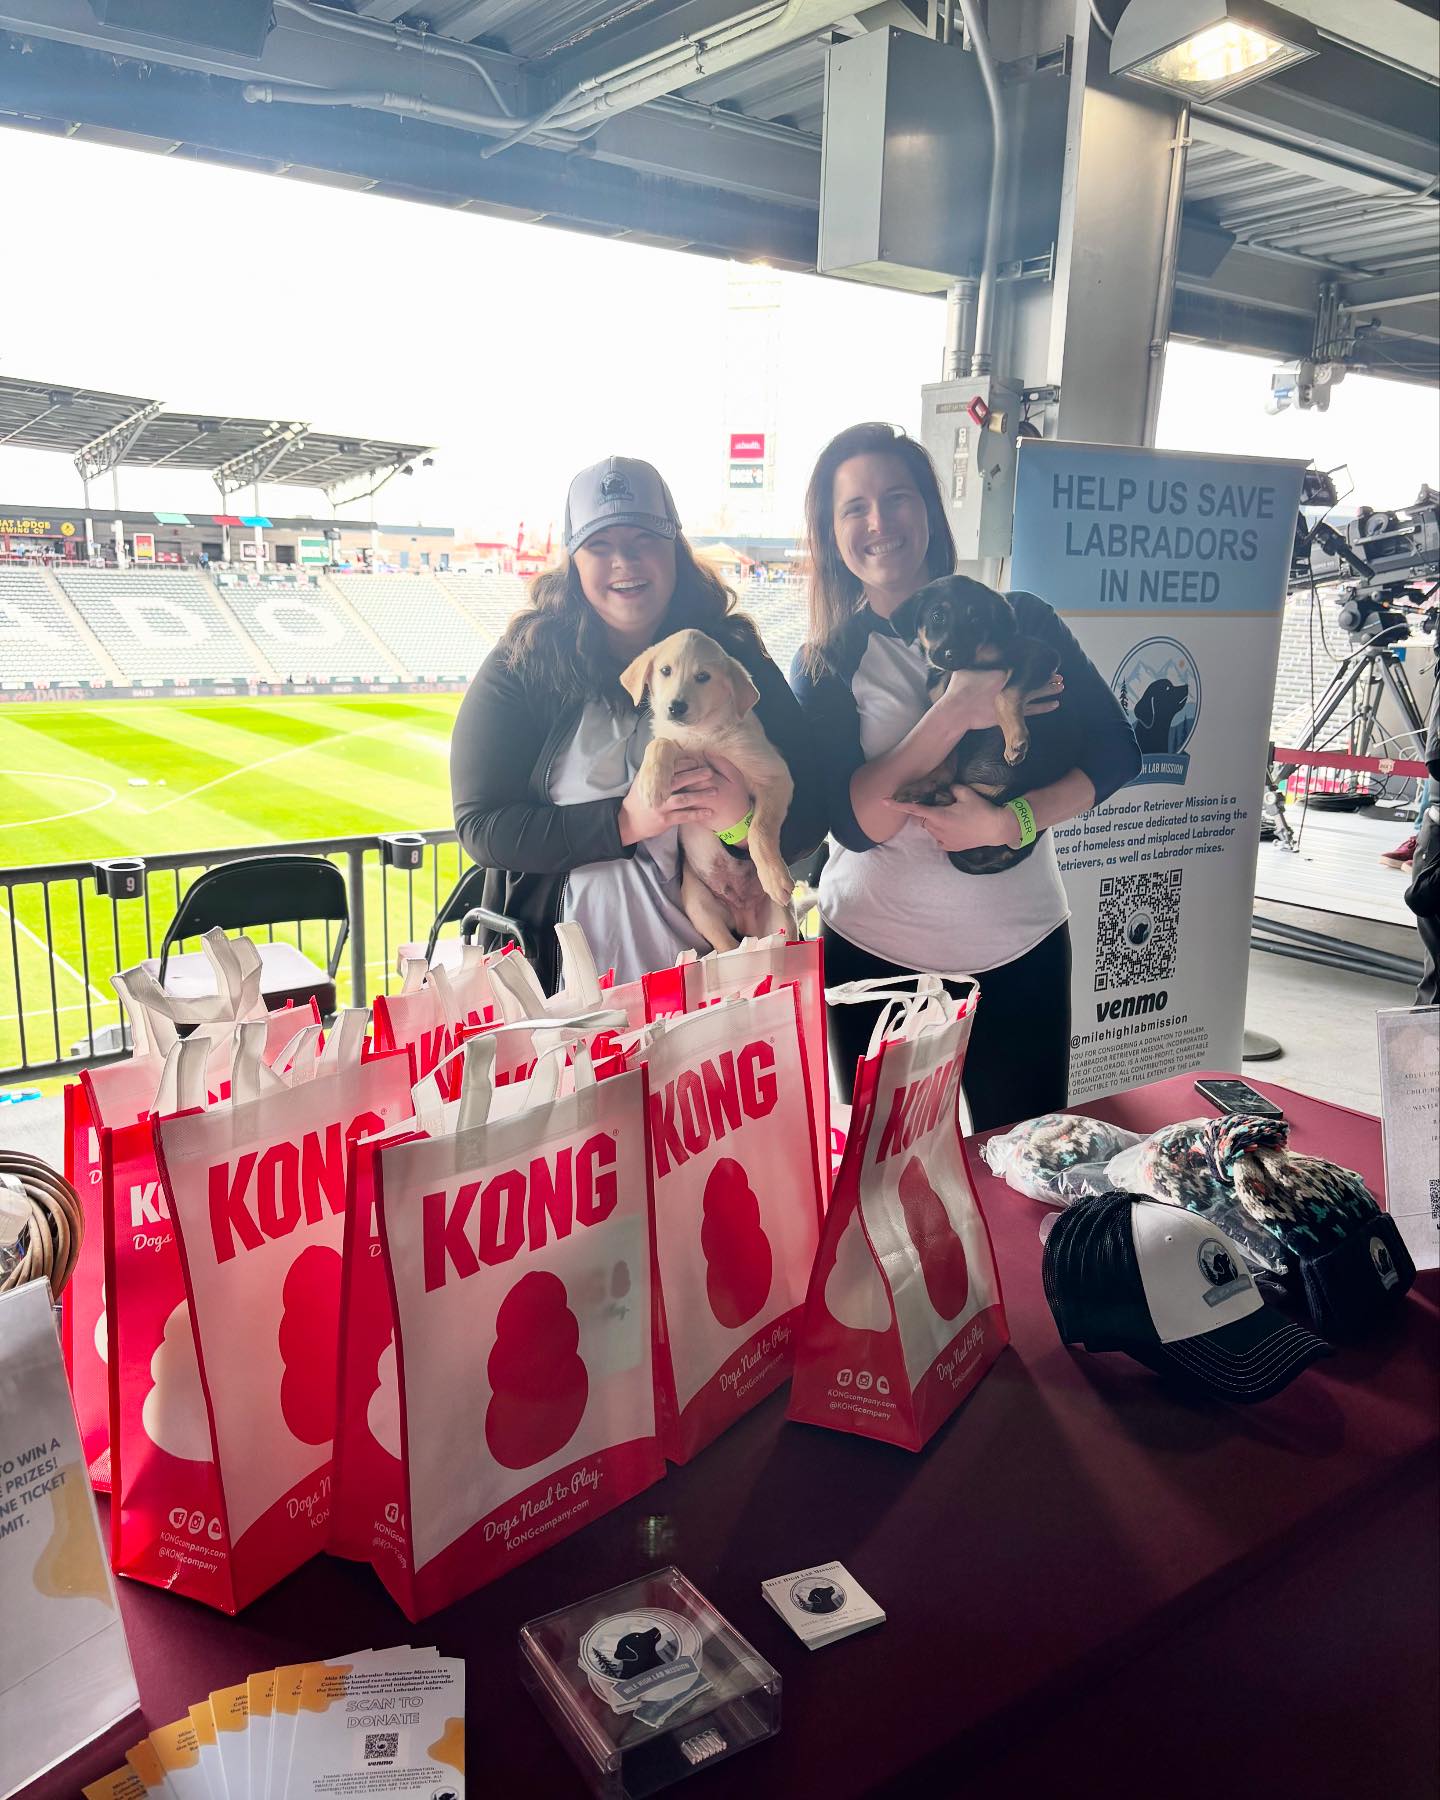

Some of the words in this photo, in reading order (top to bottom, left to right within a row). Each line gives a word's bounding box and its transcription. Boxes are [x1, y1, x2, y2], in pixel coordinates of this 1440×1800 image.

[1052, 473, 1137, 512] HELP
[1147, 480, 1187, 515] US
[1197, 482, 1275, 520] SAVE
[0, 519, 14, 528] AT
[17, 520, 51, 530] LODGE
[1065, 521, 1258, 561] LABRADORS
[1099, 568, 1128, 603] IN
[1138, 570, 1221, 603] NEED
[1148, 763, 1159, 773] LAB
[1160, 762, 1183, 775] MISSION
[1013, 800, 1033, 835] ORKER
[1097, 802, 1141, 816] Labrador
[1143, 800, 1184, 812] Retriever
[1185, 796, 1218, 807] Mission
[1221, 795, 1228, 805] is
[1052, 824, 1081, 838] orado
[1084, 820, 1111, 835] based
[1113, 821, 1143, 831] rescue
[1145, 813, 1187, 828] dedicated
[1189, 814, 1198, 823] to
[1200, 811, 1231, 823] saving
[1233, 809, 1248, 820] the
[1071, 840, 1082, 853] of
[1083, 837, 1125, 851] homeless
[1127, 834, 1145, 846] and
[1147, 829, 1190, 845] misplaced
[1192, 826, 1235, 839] Labrador
[1106, 856, 1117, 865] as
[1119, 850, 1139, 863] well
[1140, 853, 1150, 861] as
[1152, 845, 1193, 860] Labrador
[1195, 843, 1224, 854] mixes.
[411, 850, 419, 864] 8
[126, 877, 135, 892] 9
[1096, 990, 1168, 1023] venmo
[1070, 1014, 1188, 1049] @milehighlabmission
[1071, 1052, 1084, 1061] YOU
[1085, 1049, 1096, 1058] FOR
[1097, 1040, 1138, 1055] CONSIDERING
[1145, 1032, 1173, 1045] DONATION
[1175, 1030, 1182, 1038] TO
[1076, 1056, 1108, 1068] LABRADOR
[1110, 1049, 1140, 1061] RETRIEVER
[1166, 1033, 1208, 1048] INCORPORATED
[1083, 1067, 1090, 1076] OF
[1127, 1058, 1134, 1066] IS
[1176, 1041, 1208, 1055] CHARITABLE
[1072, 1081, 1109, 1096] DEDUCTIBLE
[1110, 1079, 1118, 1087] TO
[1120, 1076, 1130, 1085] THE
[1132, 1073, 1145, 1081] FULL
[1147, 1067, 1167, 1078] EXTENT
[1176, 1062, 1187, 1070] THE
[1119, 1068, 1129, 1077] ALL
[1131, 1058, 1175, 1073] CONTRIBUTIONS
[650, 1039, 778, 1179] KONG
[876, 1053, 964, 1164] KONG
[422, 1131, 619, 1293] KONG
[133, 1231, 172, 1253] Dogs
[719, 1367, 742, 1392] Dogs
[740, 1341, 763, 1374] Need
[762, 1339, 771, 1354] to
[936, 1360, 955, 1381] Dogs
[827, 1389, 897, 1409] KONGcompany.com
[829, 1401, 892, 1420] @KONGcompany
[16, 1443, 47, 1467] WIN
[50, 1438, 61, 1451] A
[6, 1456, 58, 1494] PRIZES!
[20, 1472, 66, 1505] TICKET
[286, 1493, 320, 1520] Dogs
[483, 1515, 520, 1542] Dogs
[520, 1486, 554, 1522] Need
[554, 1482, 570, 1500] to
[571, 1467, 604, 1495] Play.
[506, 1499, 590, 1551] KONGcompany.com
[158, 1546, 218, 1573] @KONGcompany
[160, 1531, 226, 1559] KONGcompany.com
[623, 1682, 640, 1694] MILE
[345, 1697, 396, 1712] SCAN
[398, 1695, 424, 1709] TO
[346, 1712, 421, 1729] DONATE
